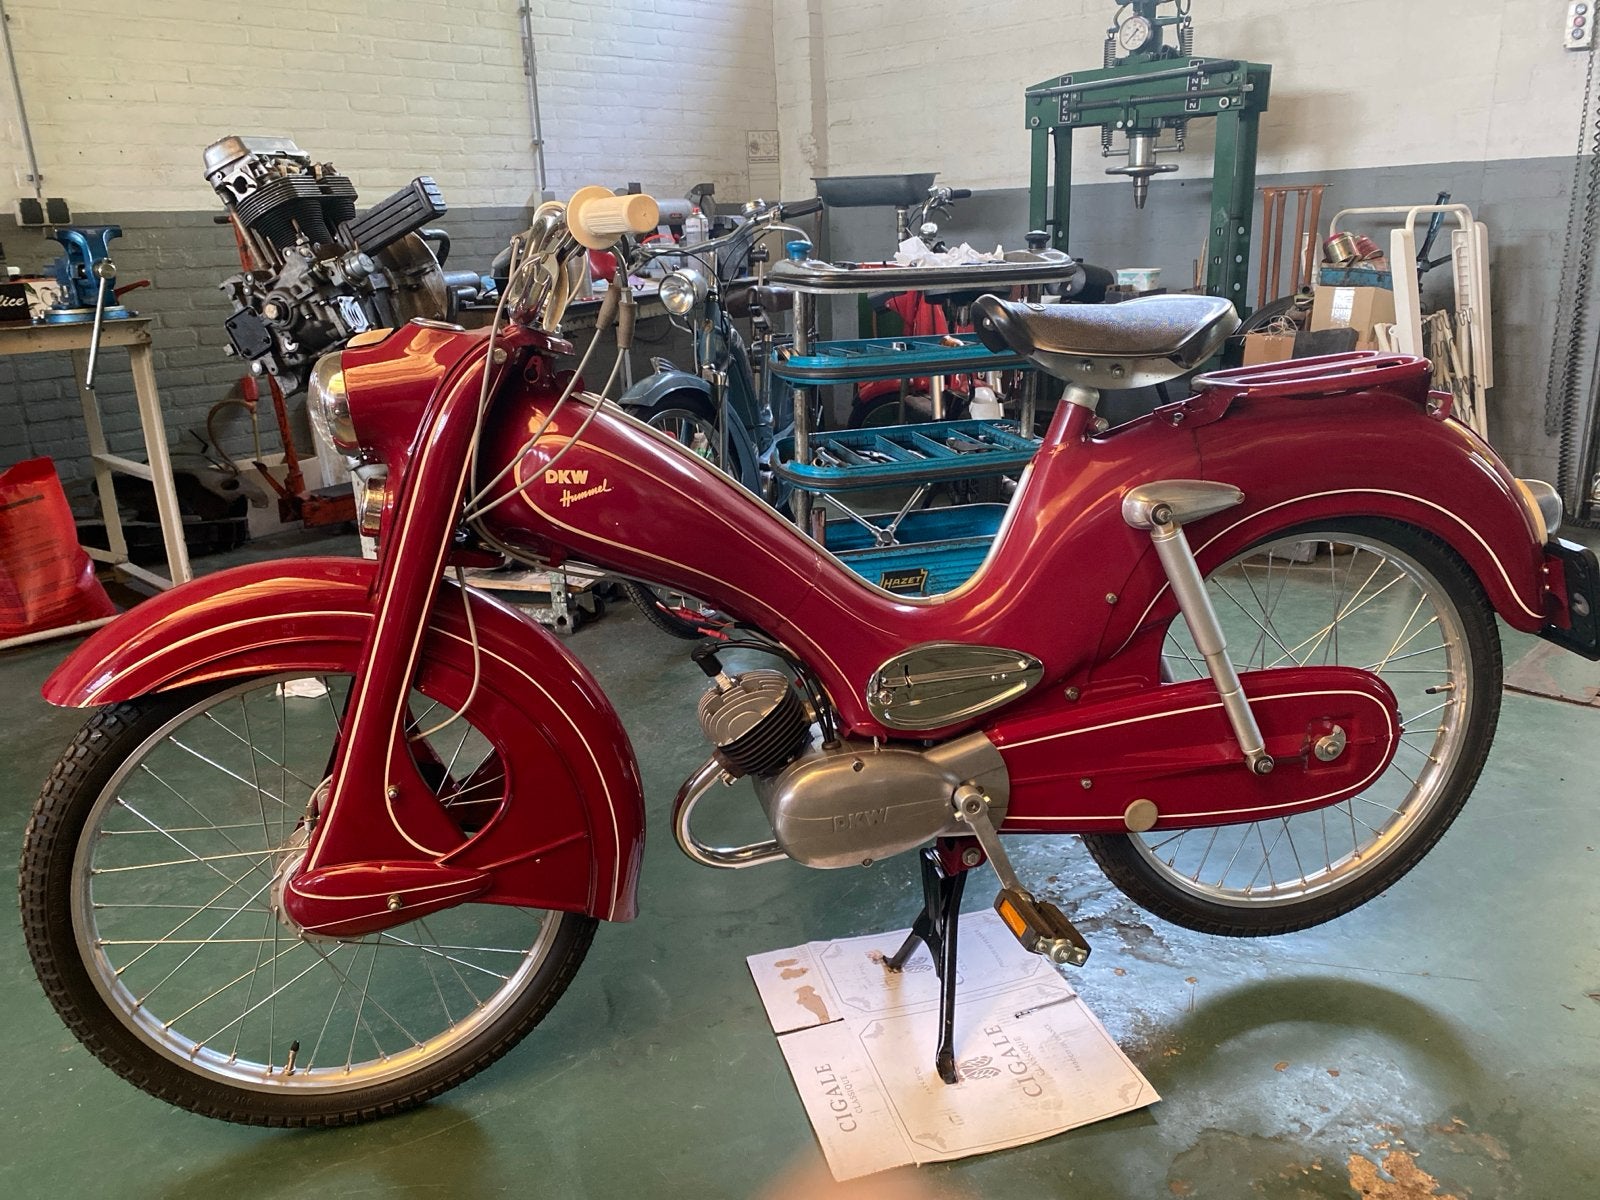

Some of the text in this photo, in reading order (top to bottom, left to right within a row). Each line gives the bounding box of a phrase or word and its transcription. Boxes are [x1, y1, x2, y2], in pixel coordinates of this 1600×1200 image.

[545, 469, 588, 485] DKW
[560, 478, 614, 507] Hummel
[884, 575, 923, 589] HAZET
[832, 807, 890, 833] DKW
[984, 1024, 1042, 1097] CIGALE
[1013, 1036, 1045, 1076] CLASSIQUE
[814, 1063, 857, 1133] CIGALE
[840, 1075, 862, 1114] CLASSIQUE
